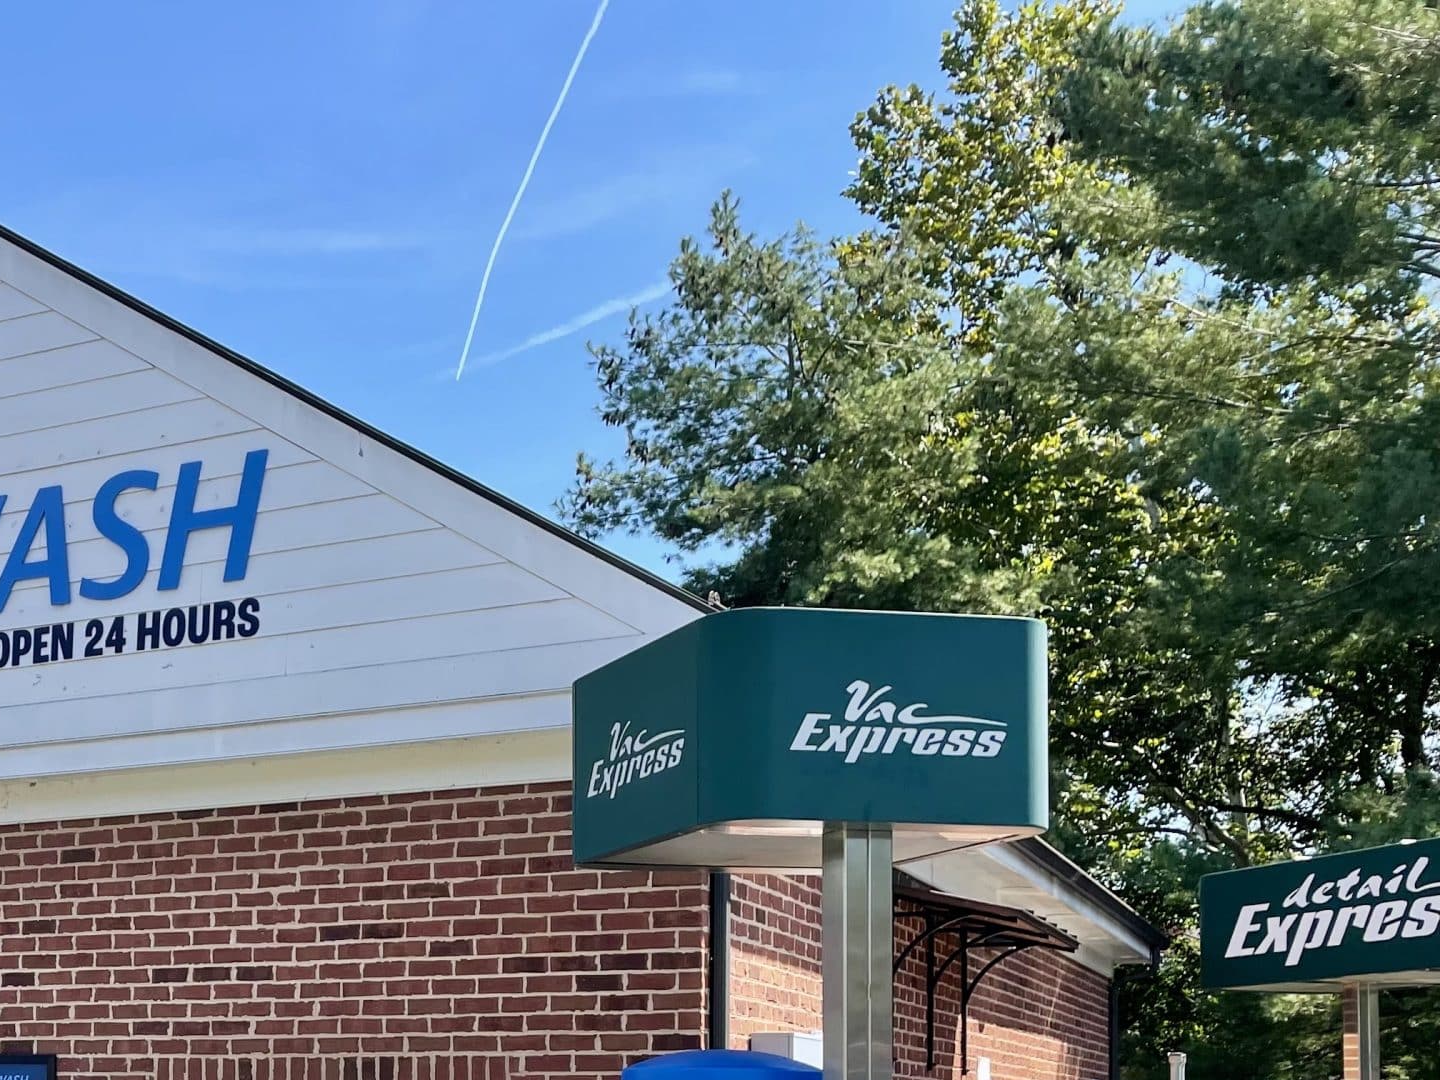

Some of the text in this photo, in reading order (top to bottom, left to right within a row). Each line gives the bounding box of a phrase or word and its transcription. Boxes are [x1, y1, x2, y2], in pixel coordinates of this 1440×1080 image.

[84, 616, 126, 657] 24
[137, 597, 260, 651] HOURS
[844, 680, 1007, 725] Vac
[611, 721, 685, 762] Vac
[789, 713, 1008, 764] Express
[587, 738, 685, 800] Express
[1283, 857, 1440, 909] detail
